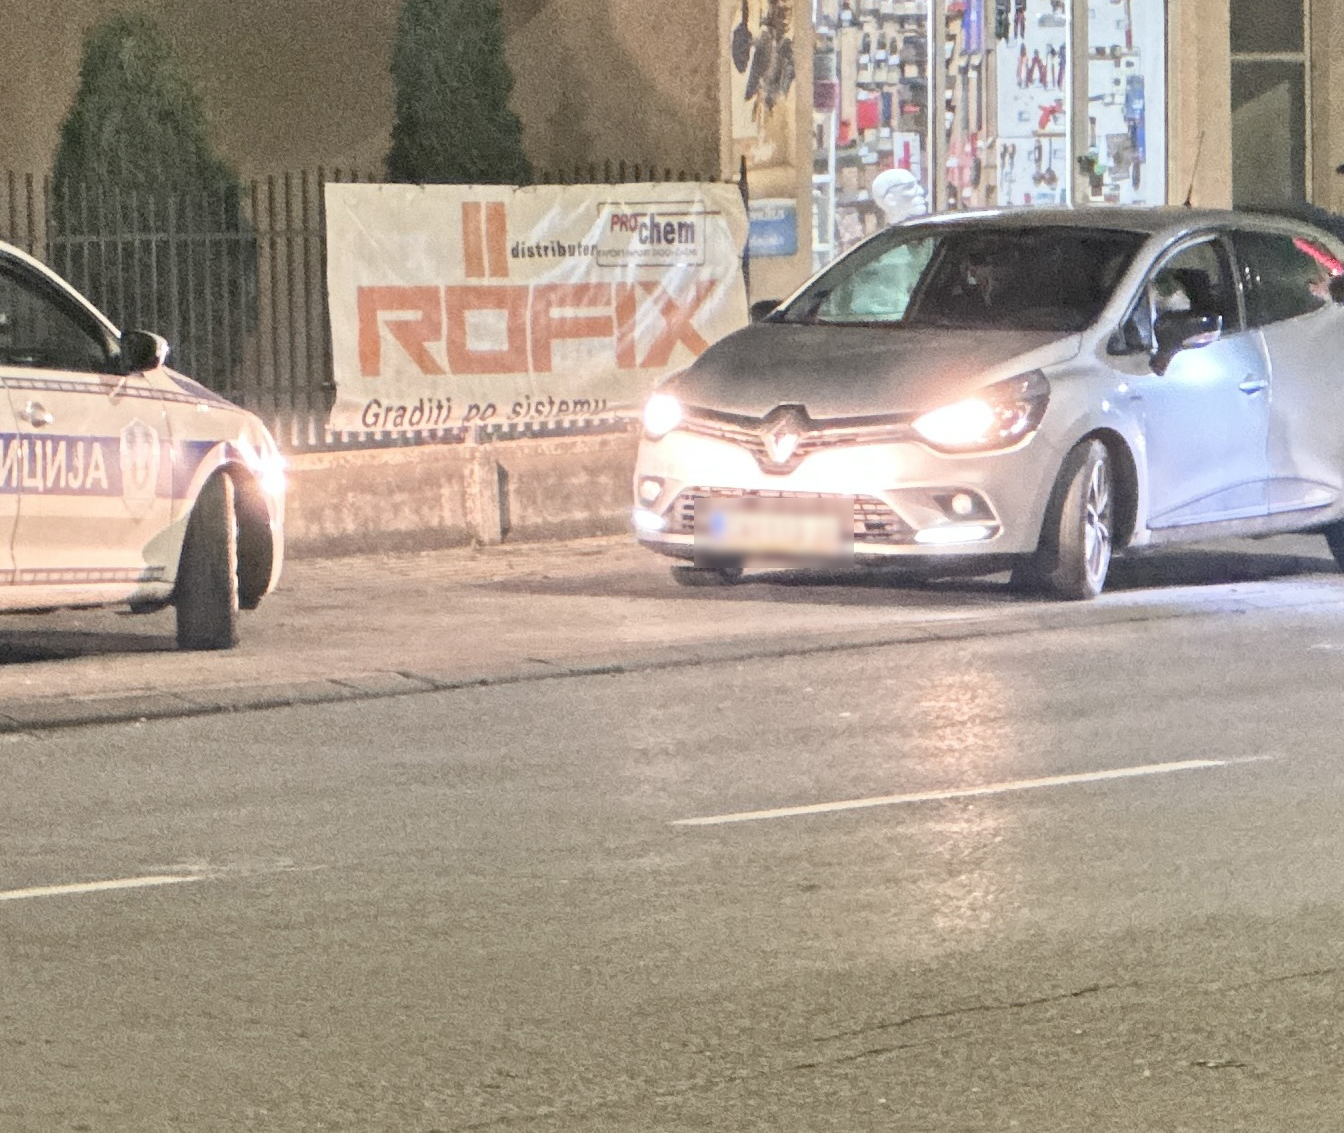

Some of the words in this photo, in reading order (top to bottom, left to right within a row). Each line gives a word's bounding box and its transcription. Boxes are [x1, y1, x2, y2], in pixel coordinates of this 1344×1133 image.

[361, 397, 453, 429] Graditi
[463, 402, 497, 422] po
[510, 394, 608, 421] sistemu
